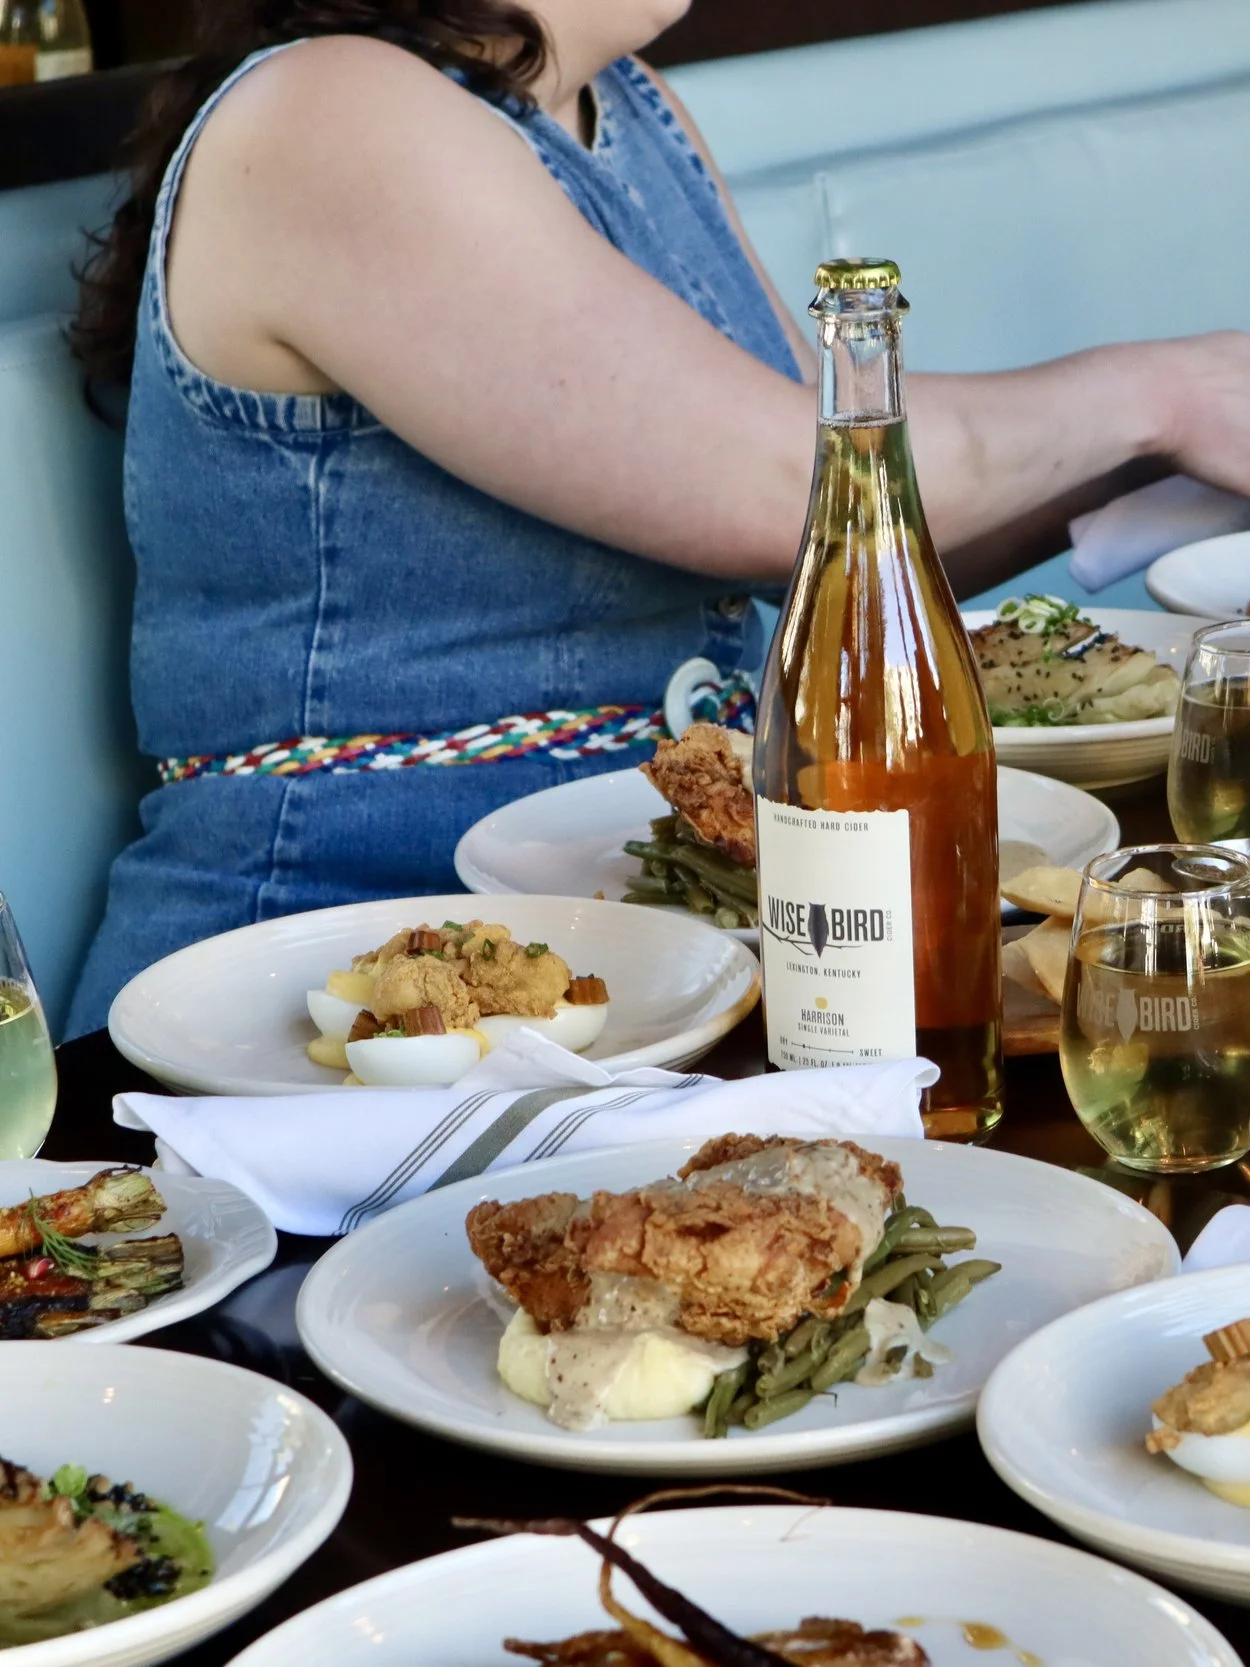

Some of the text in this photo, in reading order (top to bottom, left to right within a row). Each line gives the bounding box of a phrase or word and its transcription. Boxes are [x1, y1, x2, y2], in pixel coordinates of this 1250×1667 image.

[1181, 729, 1210, 764] BIRD
[773, 813, 869, 832] HANDCRAFTED HARD CIDER
[768, 895, 885, 942] WISE BIRD
[823, 968, 861, 979] KENTUCKY
[801, 1008, 845, 1026] HARRISON
[1140, 996, 1192, 1032] BIRD
[798, 1022, 850, 1037] SINGLE VARIETAL
[859, 1048, 882, 1057] SWEET
